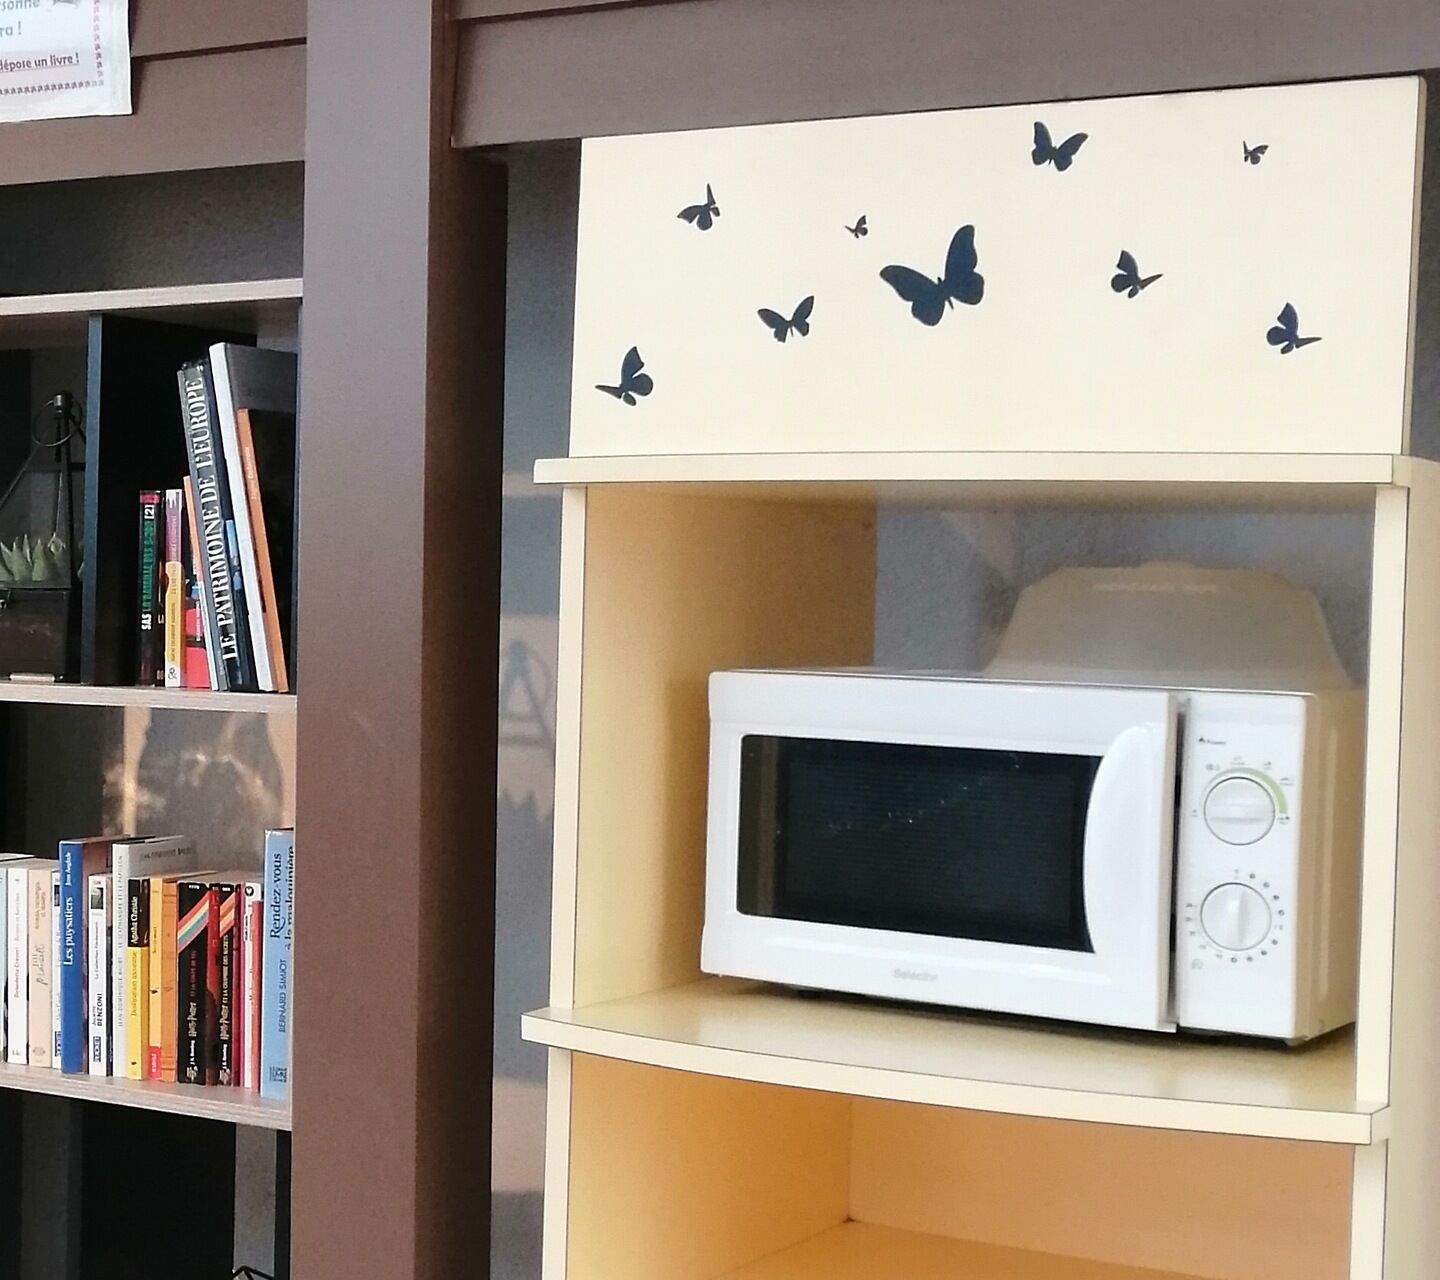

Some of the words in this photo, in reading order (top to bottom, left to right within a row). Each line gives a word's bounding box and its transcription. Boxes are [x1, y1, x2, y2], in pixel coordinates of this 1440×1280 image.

[34, 57, 47, 68] un
[50, 53, 73, 67] livre
[185, 377, 212, 470] L'EUROPE
[198, 477, 217, 504] DE
[144, 505, 155, 519] [2]
[202, 506, 233, 626] PATRIMOINE
[142, 614, 151, 630] SAS
[220, 633, 238, 659] LE
[130, 896, 139, 921] Christie
[130, 921, 139, 944] Agatha
[63, 948, 73, 966] Les
[278, 992, 286, 1033] BERNARD
